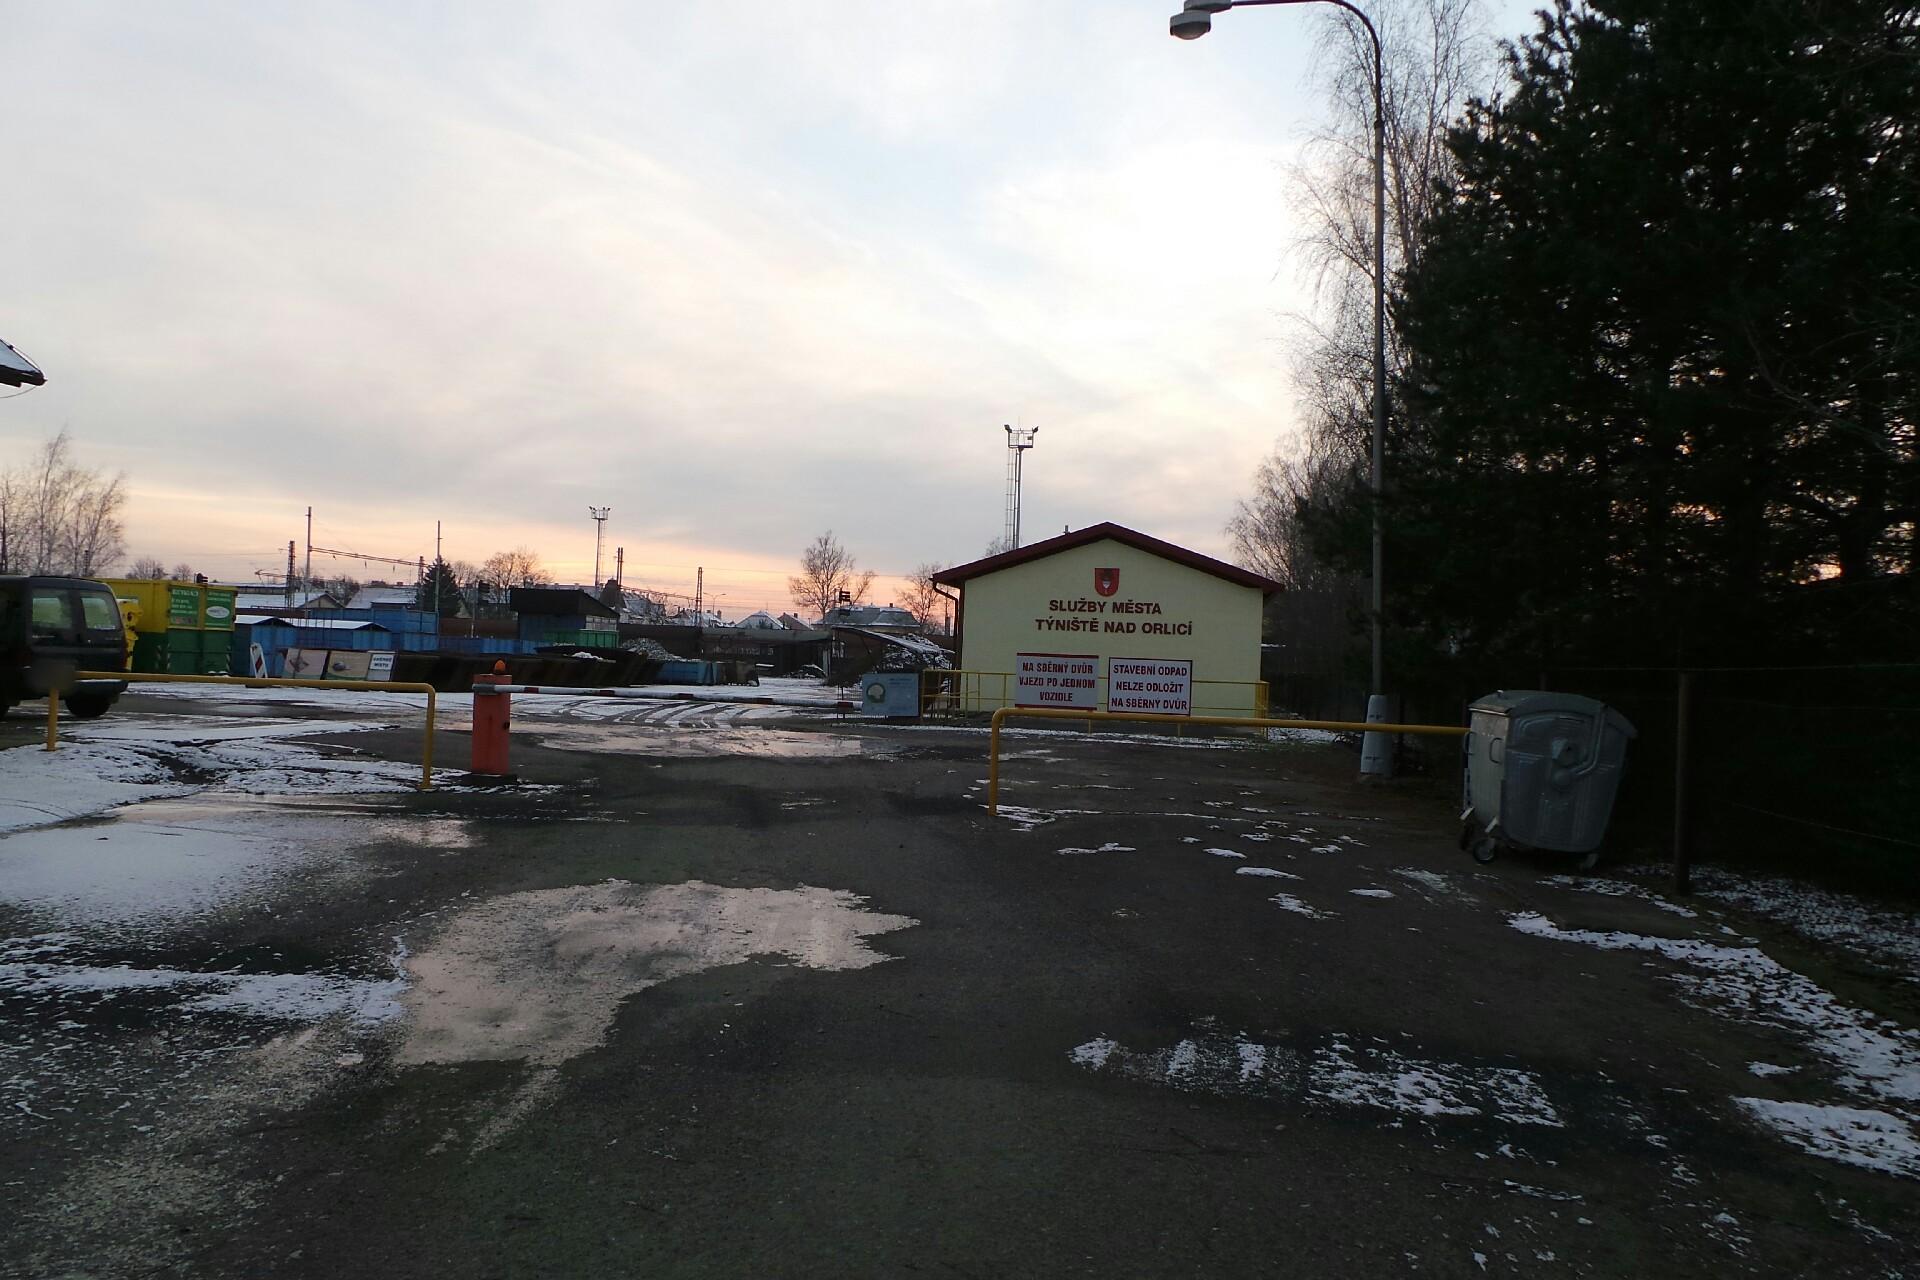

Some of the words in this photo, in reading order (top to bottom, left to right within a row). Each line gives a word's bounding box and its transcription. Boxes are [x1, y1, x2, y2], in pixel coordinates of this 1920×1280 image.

[1049, 598, 1107, 613] SLUŽBY
[1112, 599, 1162, 614] MĚSTA
[1035, 616, 1099, 633] TÝNIŠTĚ
[1104, 621, 1136, 634] NAD
[1141, 621, 1193, 636] ORLICÍ
[1022, 662, 1034, 672] NA
[1036, 661, 1069, 673] SBĚRNÝ
[1113, 664, 1155, 675] STAVEBNÍ
[1158, 665, 1187, 676] ODPAD
[1019, 676, 1044, 686] VJEZD
[1047, 677, 1058, 687] PO
[1060, 678, 1096, 688] JEDNOM
[1116, 681, 1144, 691] NELZE
[1146, 681, 1184, 693] ODLOŽIT
[1039, 691, 1073, 702] VOZIDLE
[1111, 697, 1124, 707] NA
[1125, 697, 1161, 709] SBĚRNÝ
